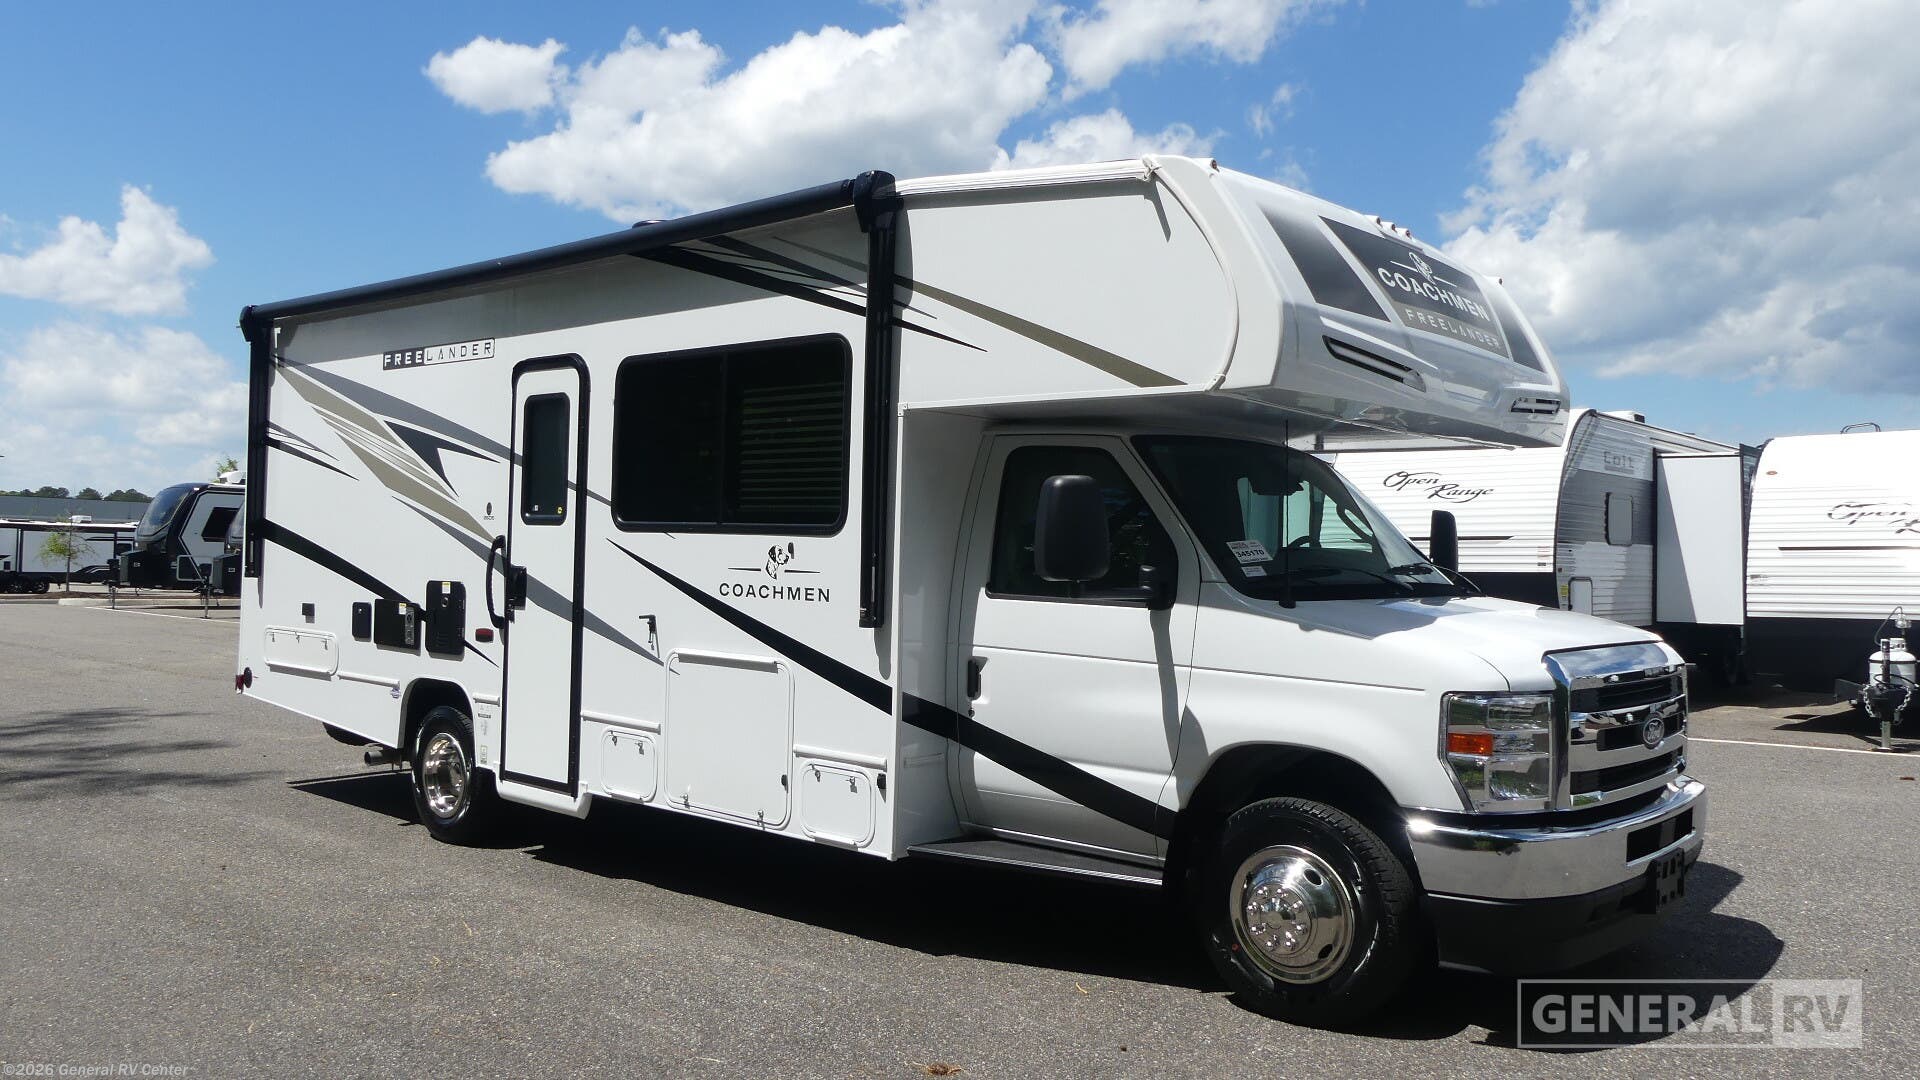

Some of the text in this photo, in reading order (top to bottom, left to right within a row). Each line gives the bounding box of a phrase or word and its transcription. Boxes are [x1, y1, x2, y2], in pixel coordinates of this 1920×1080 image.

[1377, 267, 1491, 322] COACHMEN
[1404, 308, 1500, 347] FREELANDER
[384, 342, 492, 367] FREELANDER
[1383, 471, 1494, 503] Open Range
[719, 582, 830, 602] COACHMEN
